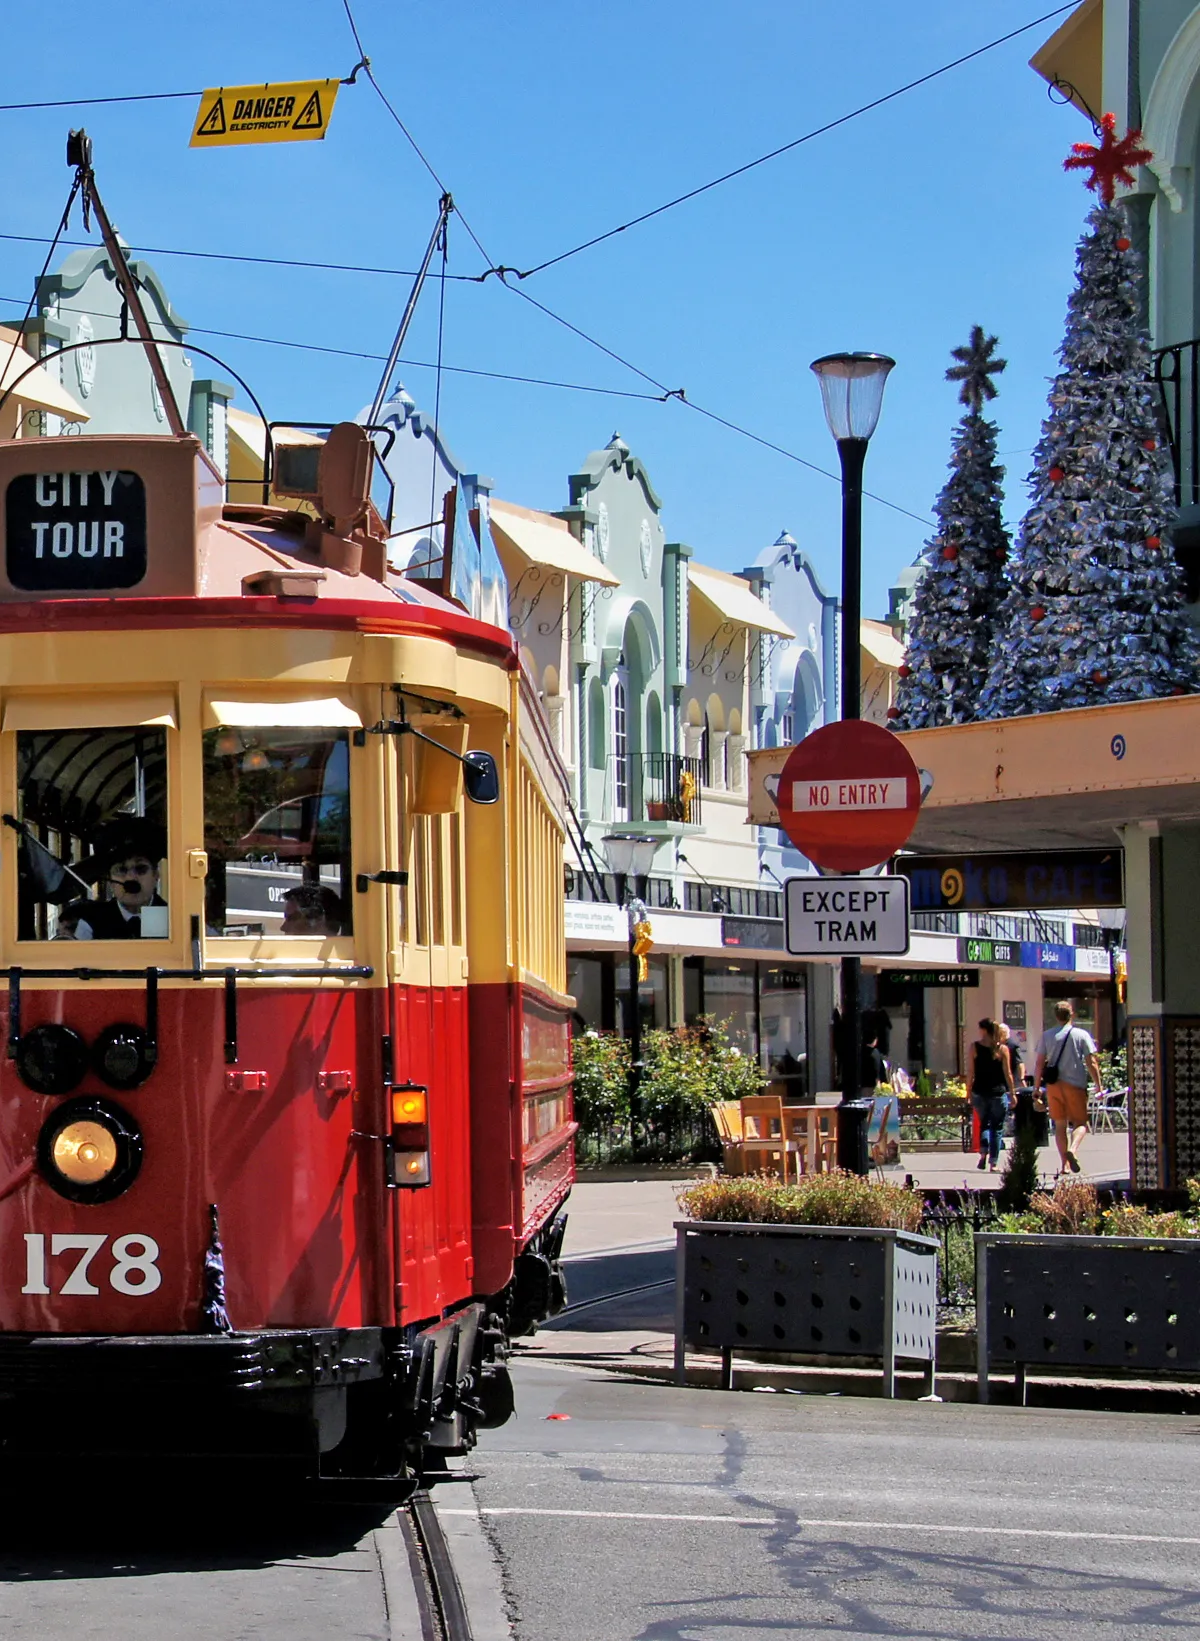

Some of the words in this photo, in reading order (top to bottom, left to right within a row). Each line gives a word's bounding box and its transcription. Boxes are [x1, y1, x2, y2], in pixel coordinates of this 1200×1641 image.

[232, 96, 296, 121] DANGER
[229, 120, 290, 132] ELECTRICITY
[35, 470, 119, 507] CITY
[31, 521, 125, 559] TOUR
[809, 785, 830, 806] NO
[839, 783, 889, 805] ENTRY
[1025, 855, 1115, 904] CAFÉ
[802, 891, 890, 912] EXCEPT
[814, 920, 877, 941] TRAM
[994, 945, 1010, 960] GIFTS
[938, 974, 969, 982] GIFTS
[21, 1233, 162, 1296] 178
